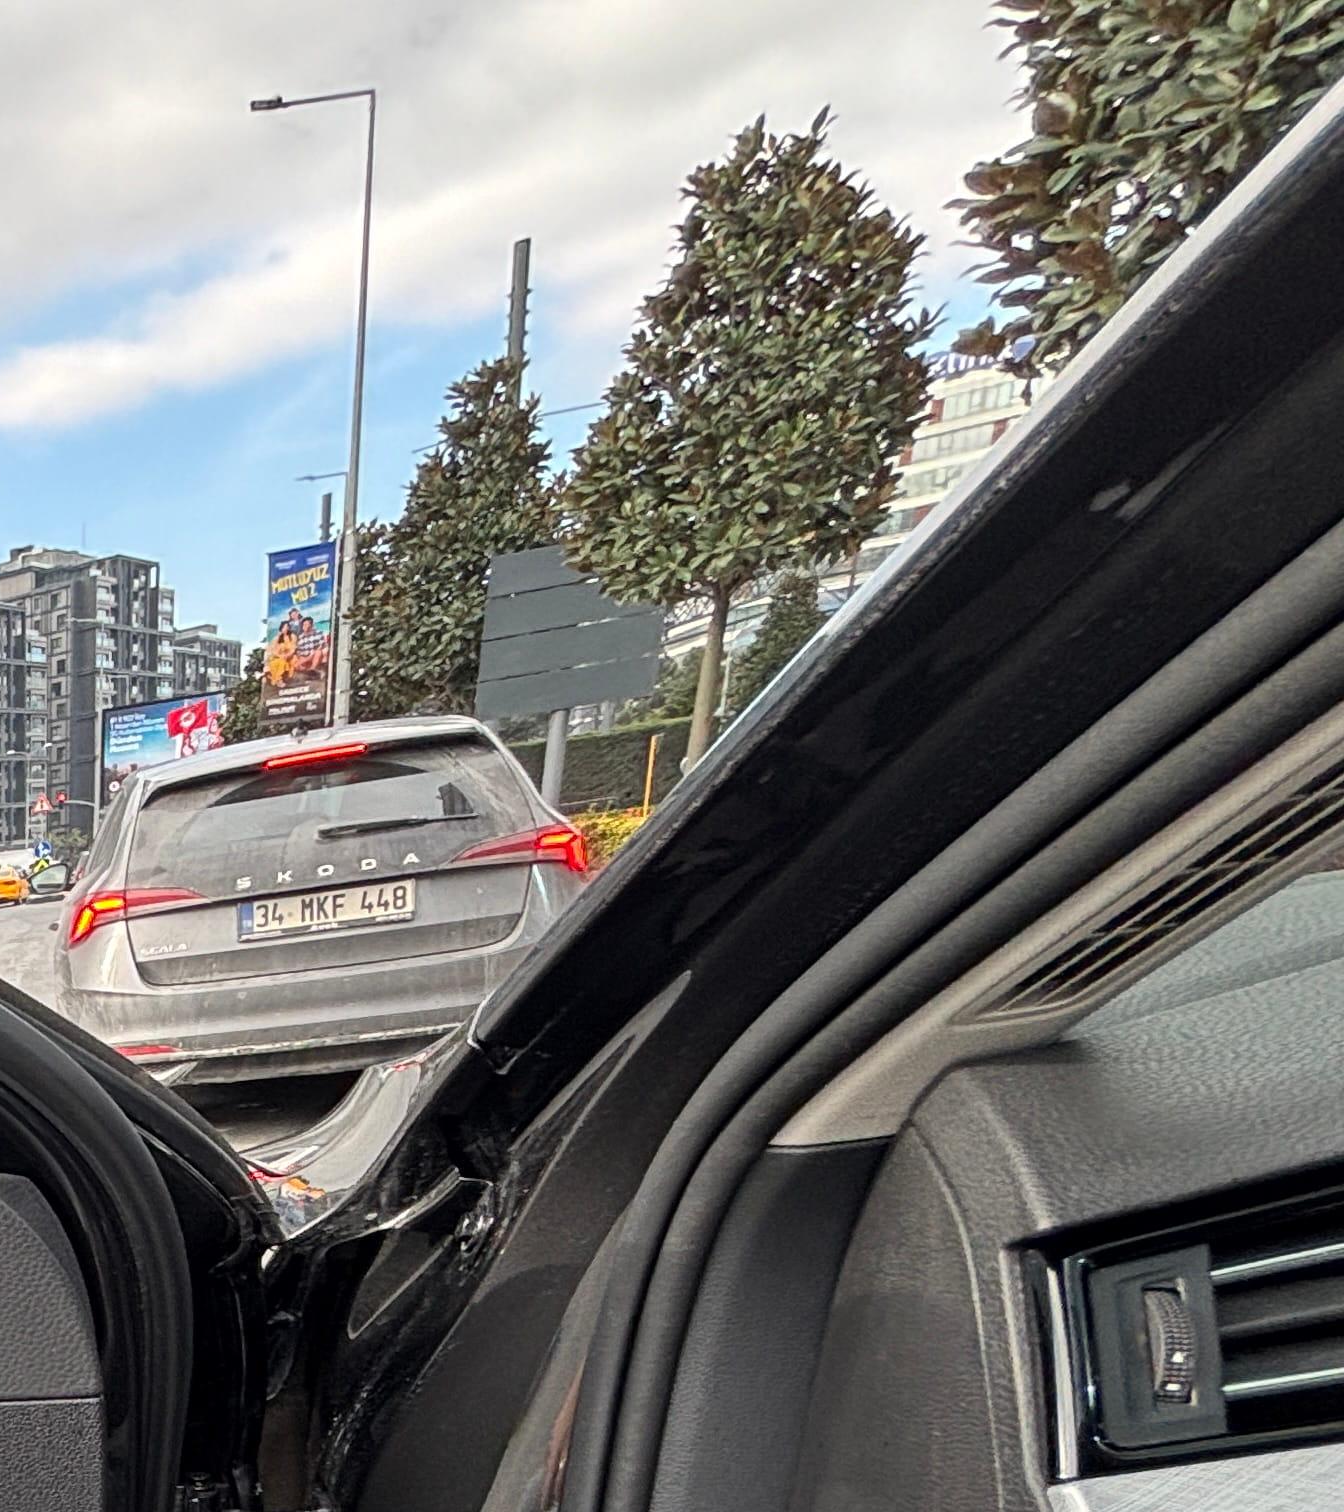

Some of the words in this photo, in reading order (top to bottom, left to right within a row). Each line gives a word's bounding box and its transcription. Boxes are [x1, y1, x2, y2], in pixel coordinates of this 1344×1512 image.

[235, 853, 421, 890] SKODA
[255, 902, 285, 928] 34
[300, 893, 347, 923] MKF
[360, 885, 408, 914] 448
